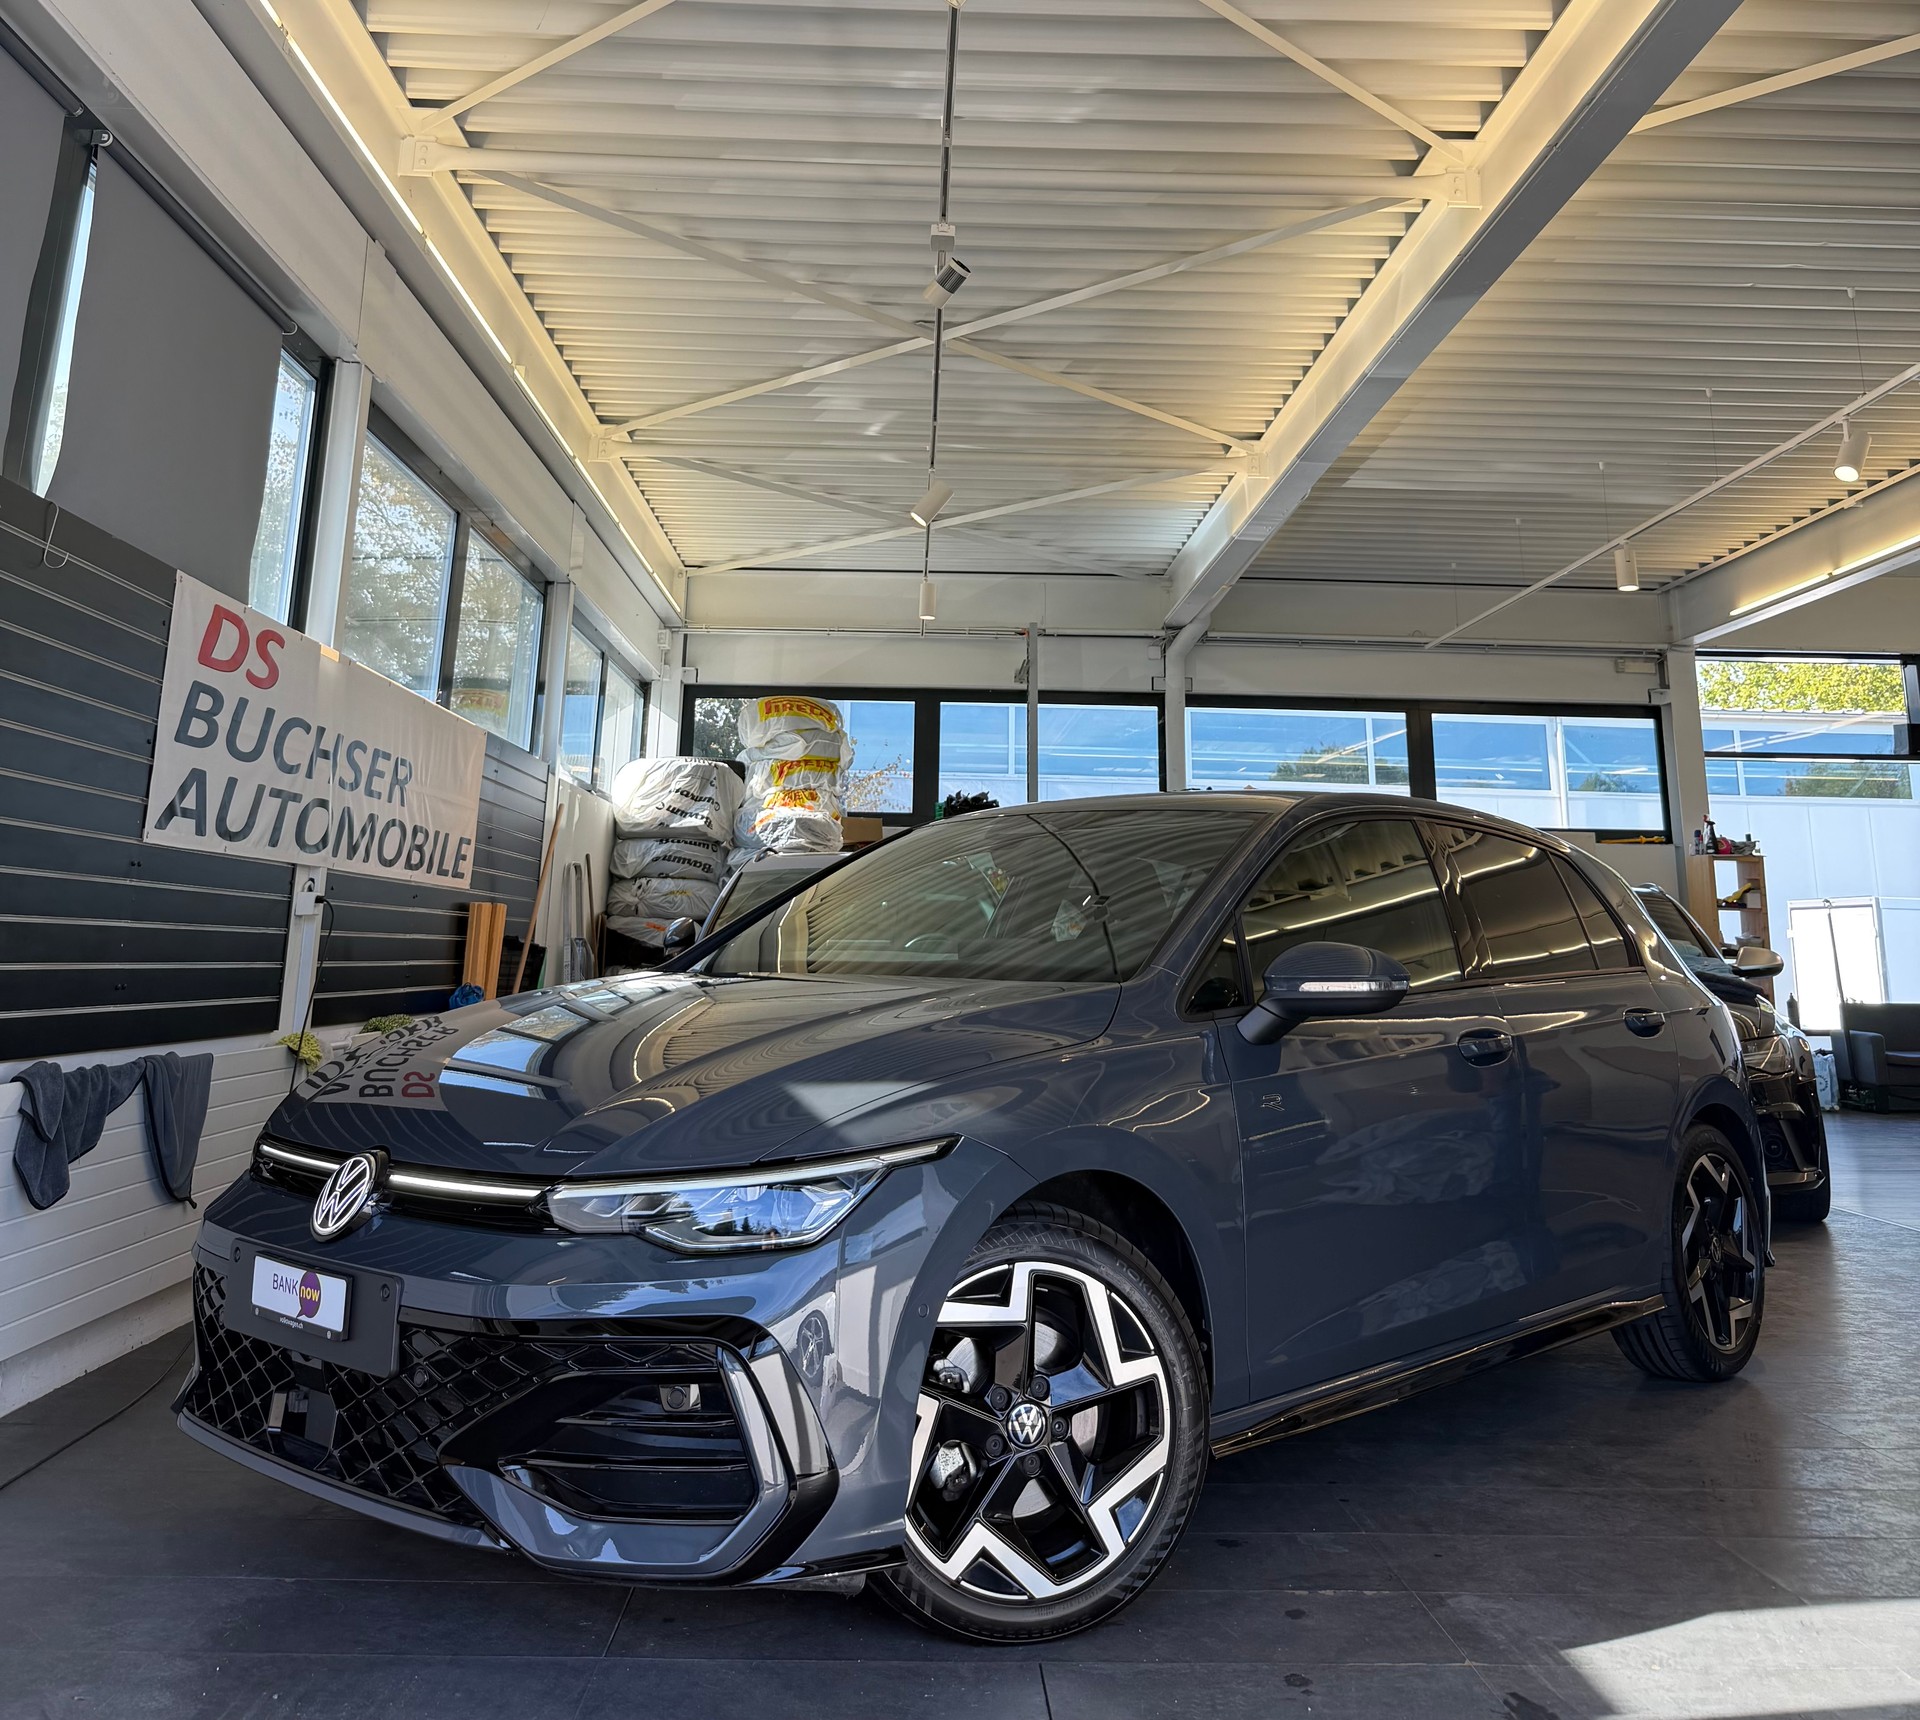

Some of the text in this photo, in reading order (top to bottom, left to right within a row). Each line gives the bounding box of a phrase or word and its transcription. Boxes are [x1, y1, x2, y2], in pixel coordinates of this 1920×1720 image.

[197, 603, 285, 690] DS
[174, 680, 413, 807] BUCHSER
[154, 767, 471, 880] AUTOMOBILE
[315, 1157, 370, 1233] VW
[272, 1272, 320, 1303] BANK now
[1009, 1403, 1046, 1447] VW
